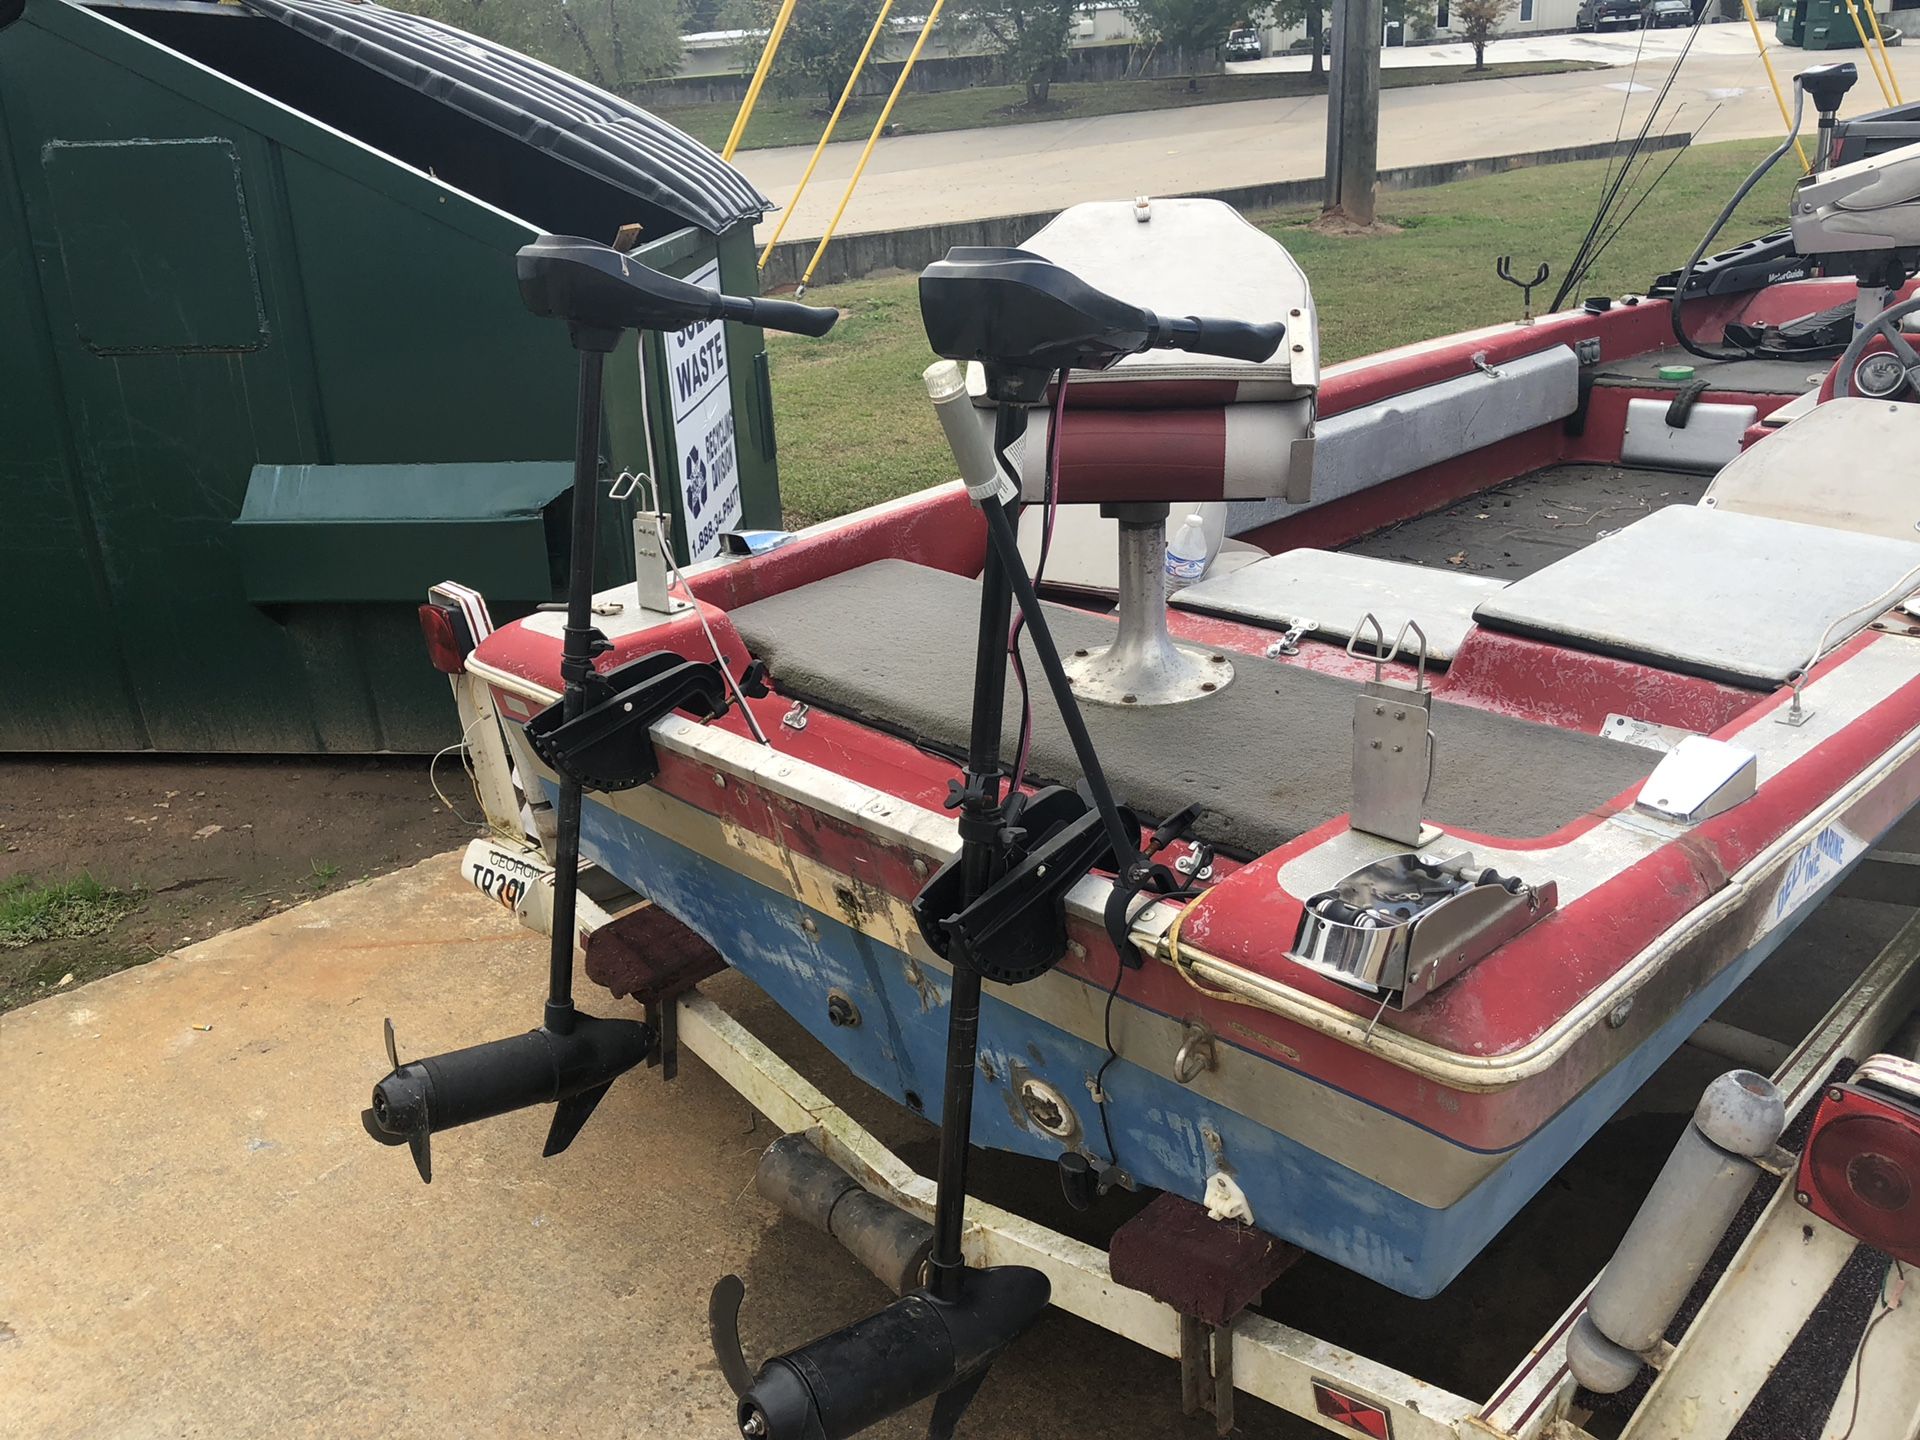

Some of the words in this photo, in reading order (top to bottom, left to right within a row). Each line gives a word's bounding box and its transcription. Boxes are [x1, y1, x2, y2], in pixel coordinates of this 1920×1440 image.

[676, 331, 724, 403] WASTE
[711, 443, 734, 492] DIVISION
[1817, 826, 1844, 865] MARINE
